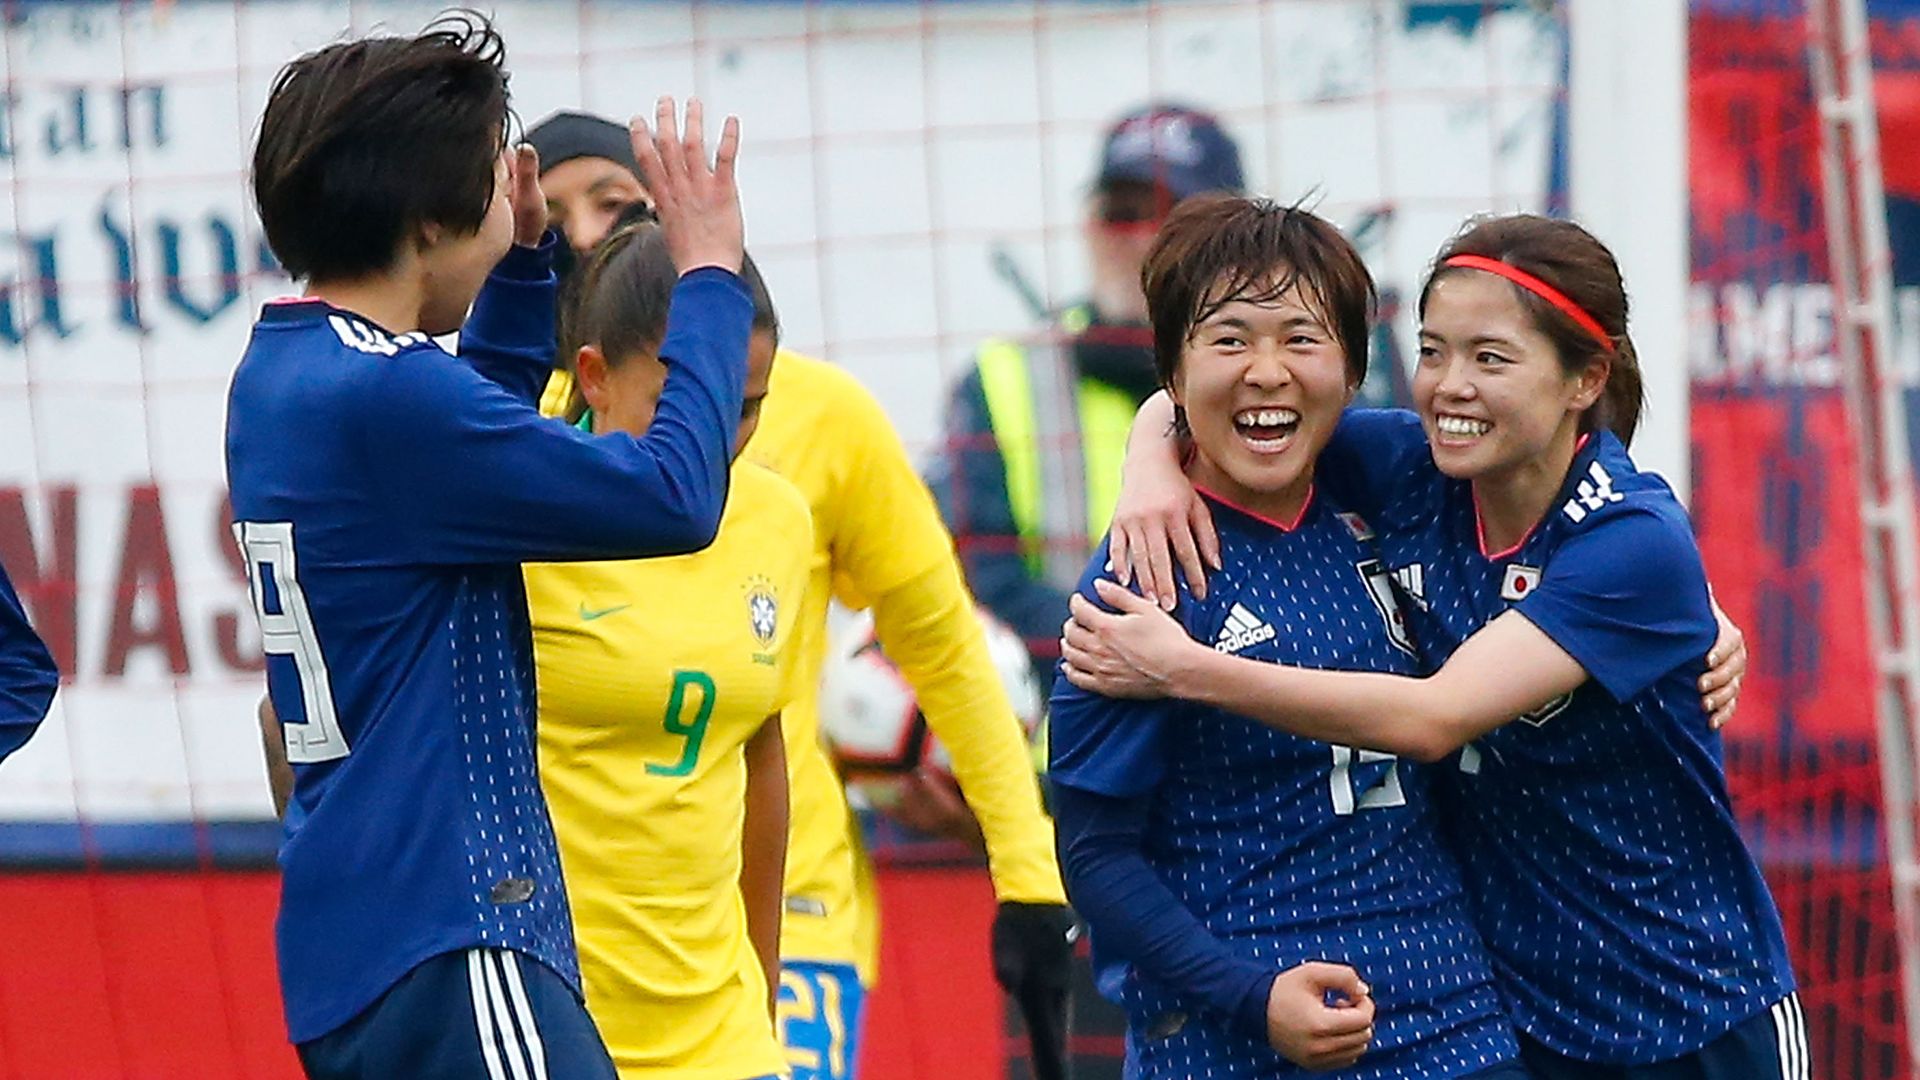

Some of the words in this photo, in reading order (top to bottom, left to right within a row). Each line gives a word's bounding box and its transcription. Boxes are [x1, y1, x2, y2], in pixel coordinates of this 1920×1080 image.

[0, 188, 284, 341] aw
[232, 521, 351, 764] 9
[1214, 622, 1276, 654] adidas
[645, 671, 716, 777] 9
[774, 969, 846, 1080] 21
